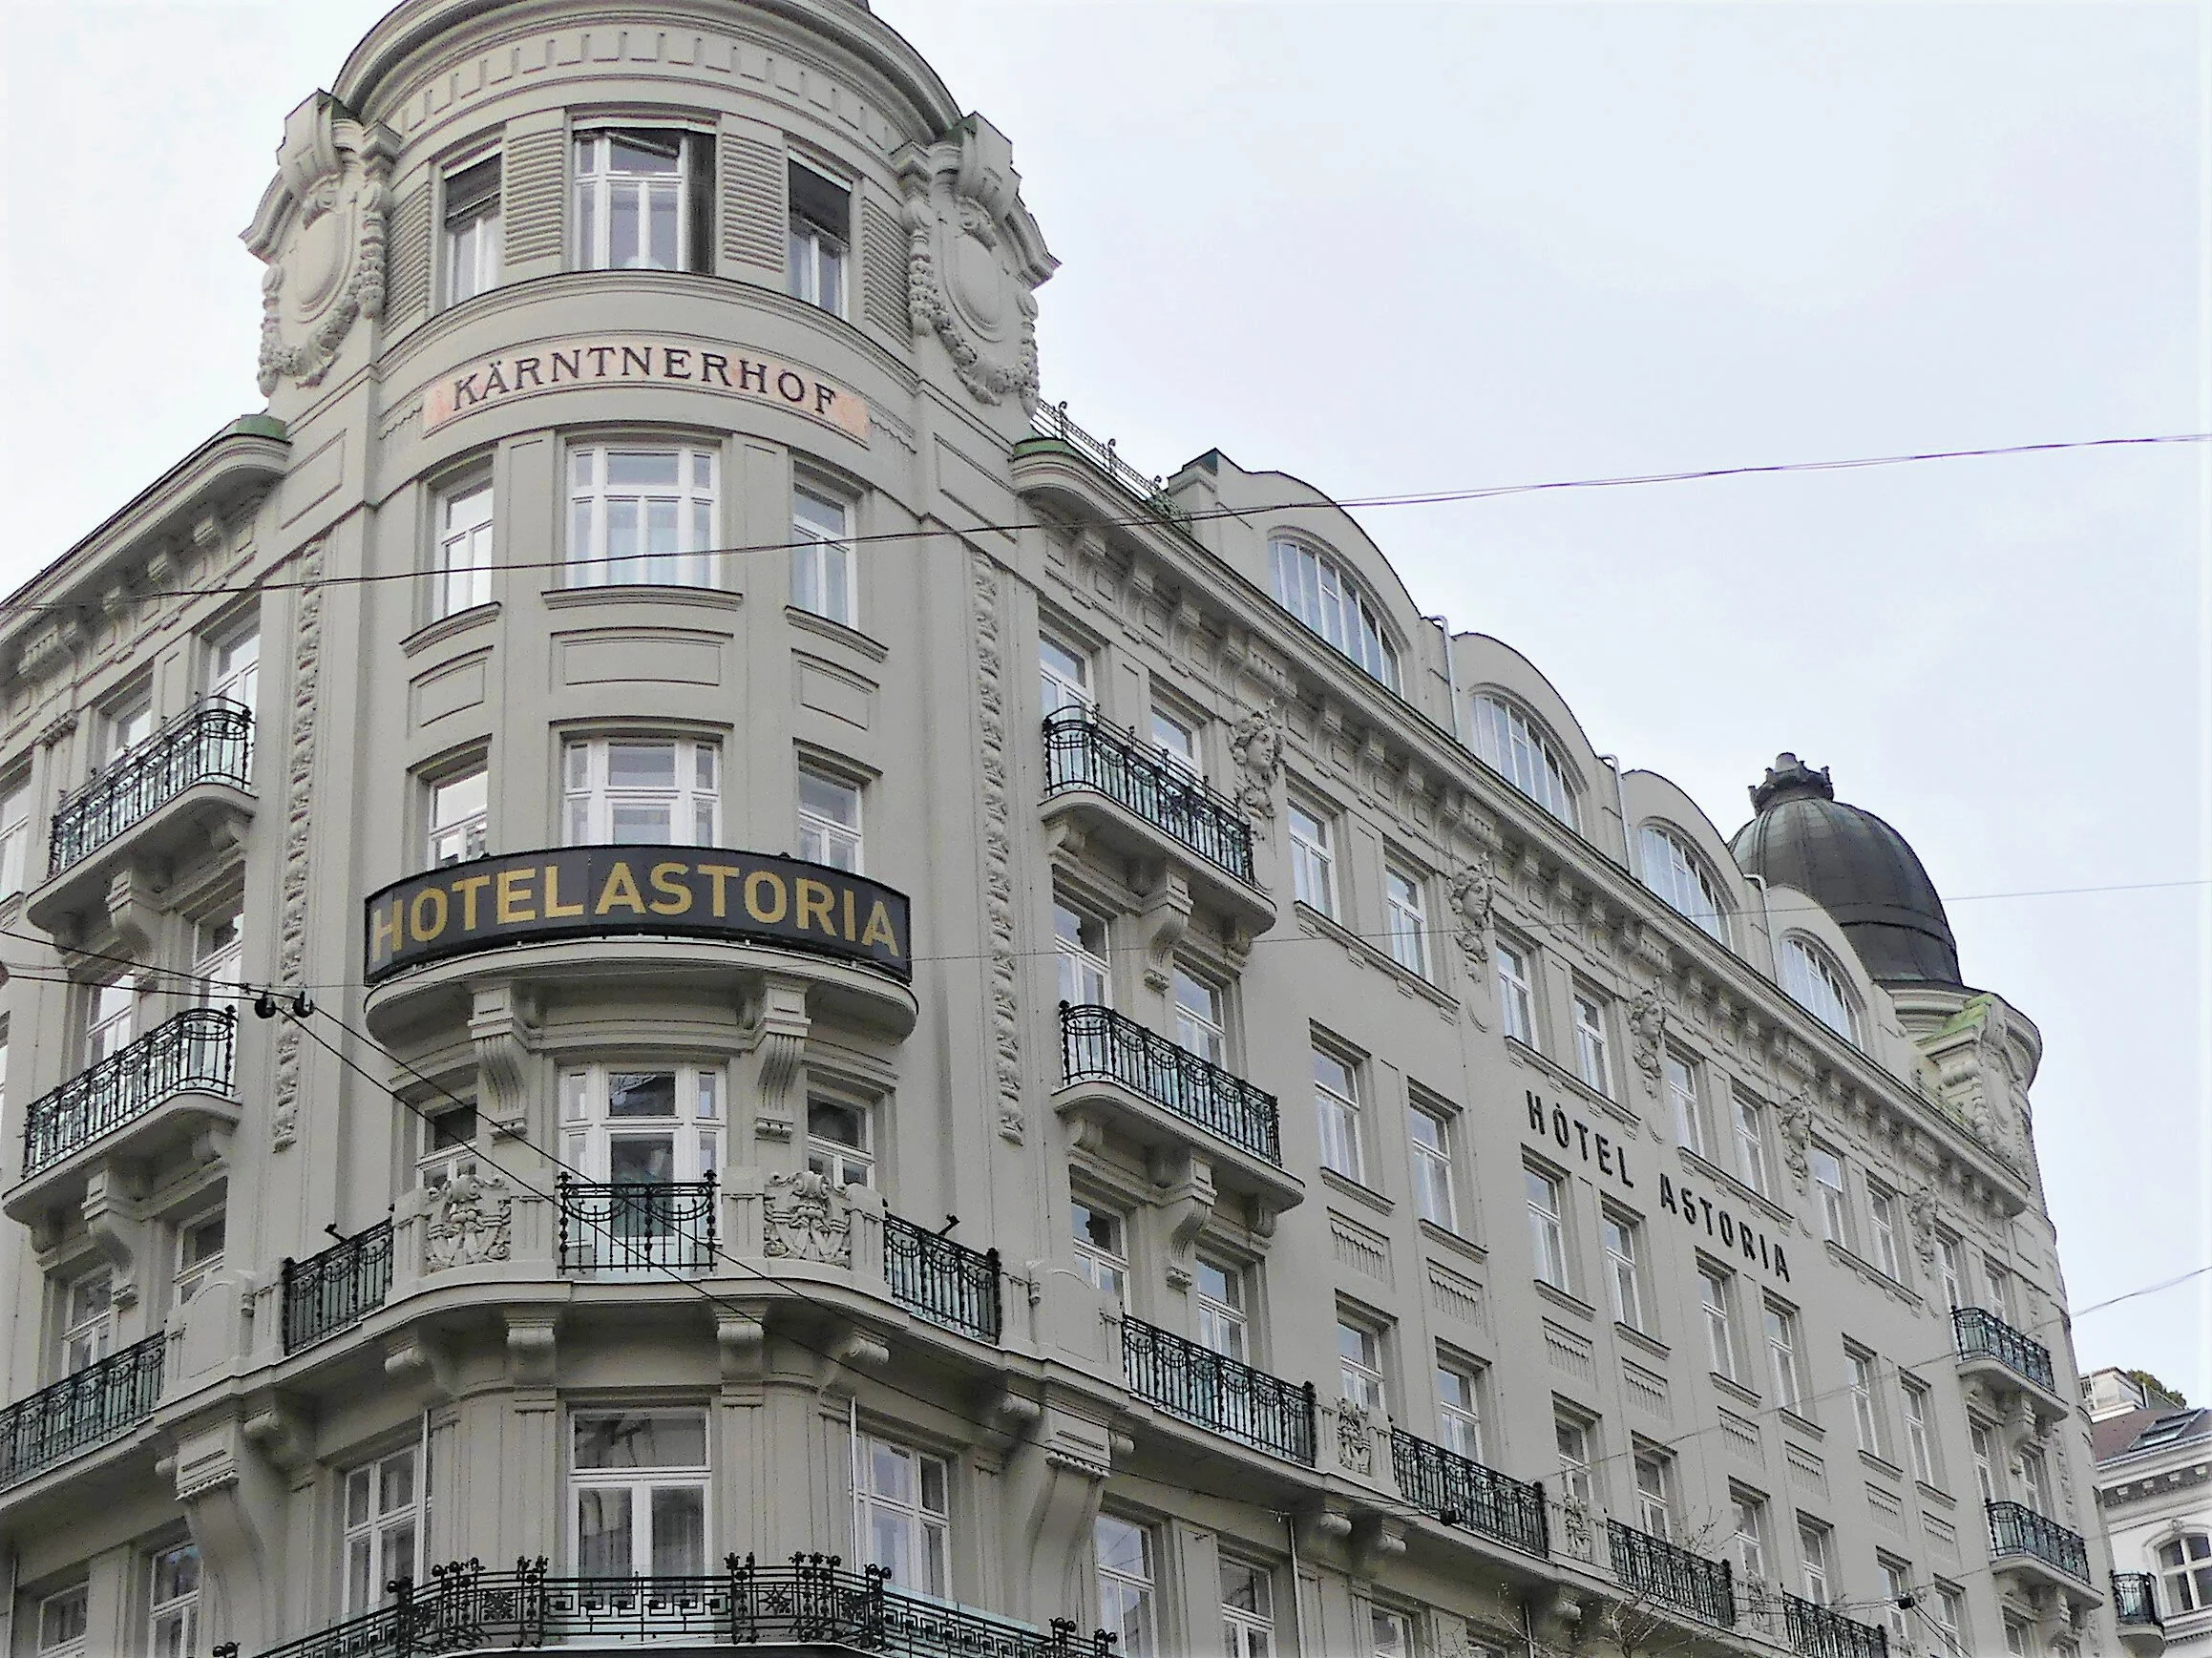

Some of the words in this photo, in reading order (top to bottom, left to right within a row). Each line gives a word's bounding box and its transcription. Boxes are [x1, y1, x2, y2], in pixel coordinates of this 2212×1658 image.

[453, 346, 836, 415] KÄRNTNERHOF
[372, 863, 584, 962] HOTEL
[595, 862, 898, 956] ASTORIA
[1660, 1172, 1790, 1283] ASTORIA
